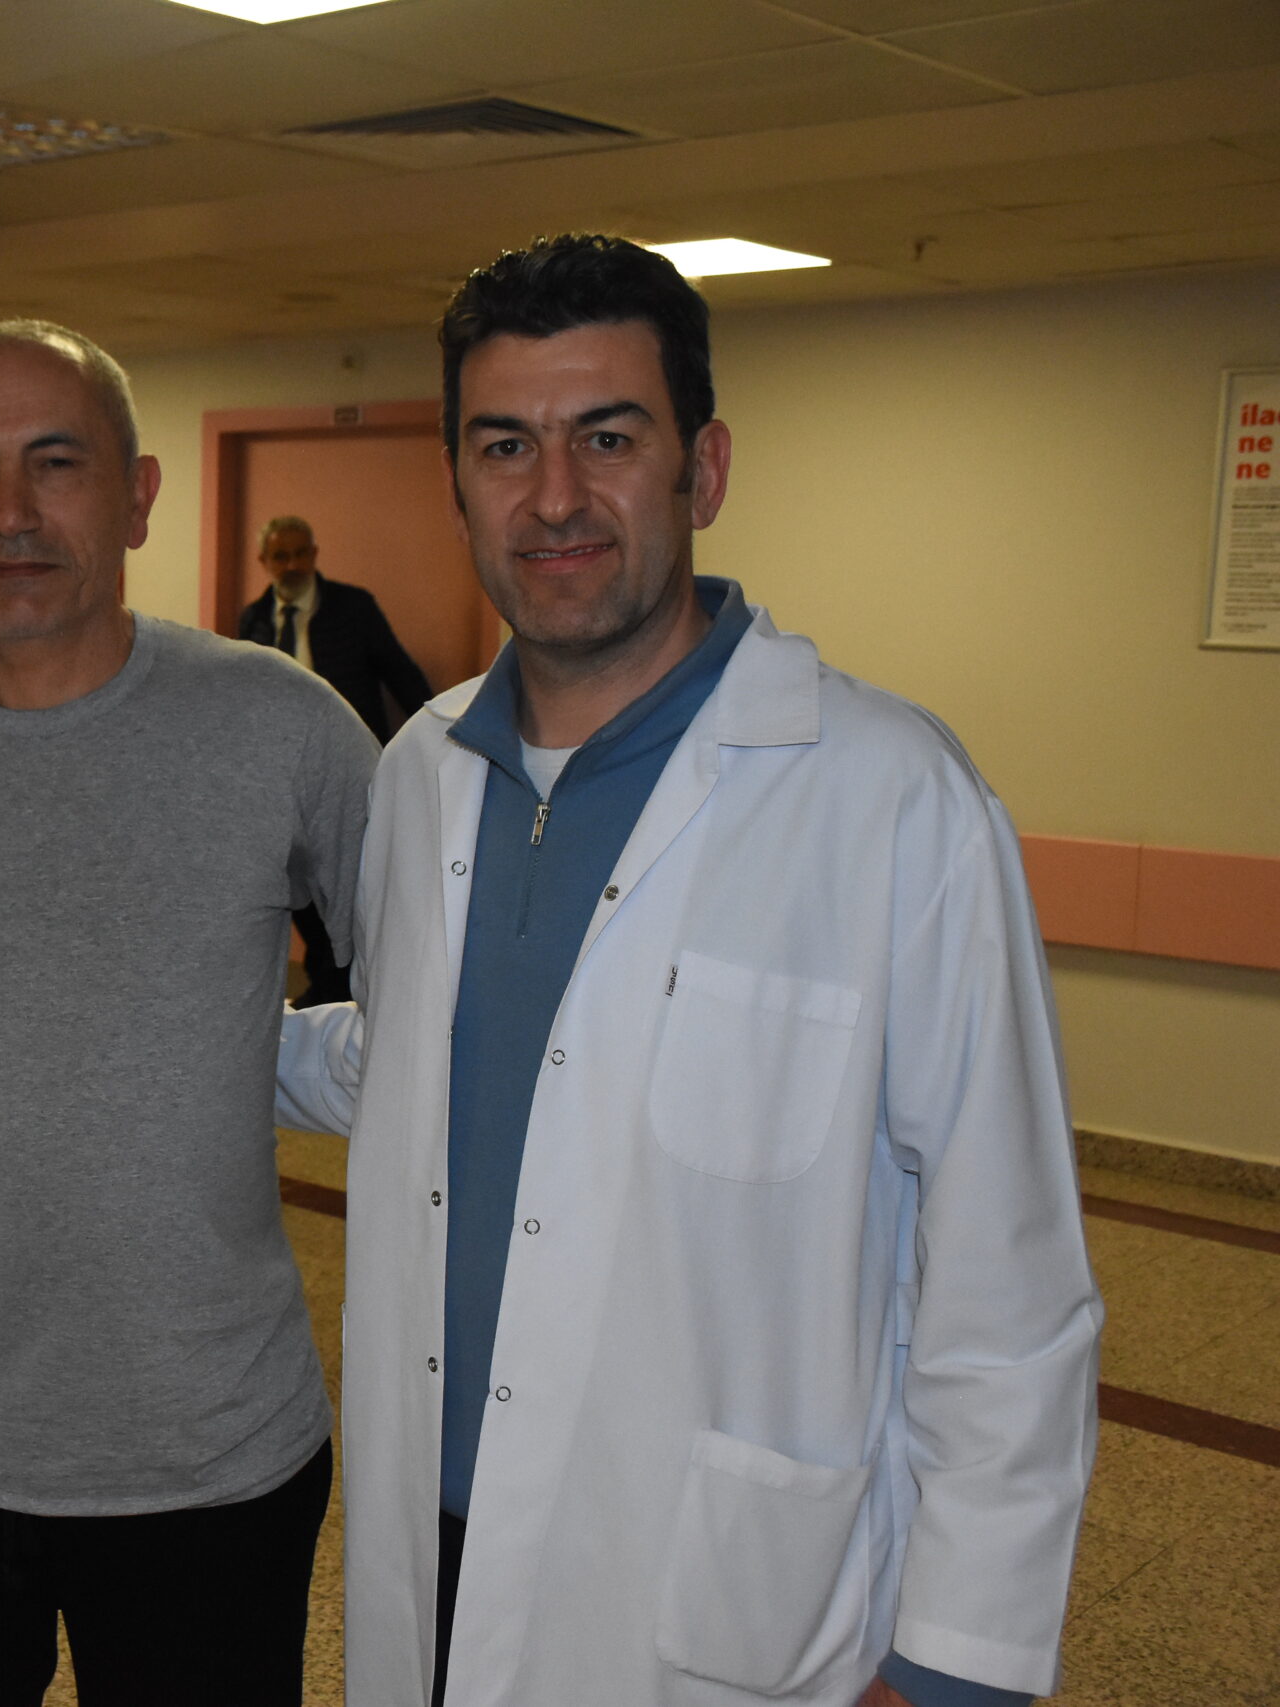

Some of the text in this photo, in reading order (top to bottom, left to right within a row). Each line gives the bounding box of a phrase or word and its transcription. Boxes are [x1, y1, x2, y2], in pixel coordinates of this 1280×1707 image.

[1241, 403, 1280, 427] ila
[1238, 436, 1273, 453] ne
[1236, 462, 1271, 479] ne
